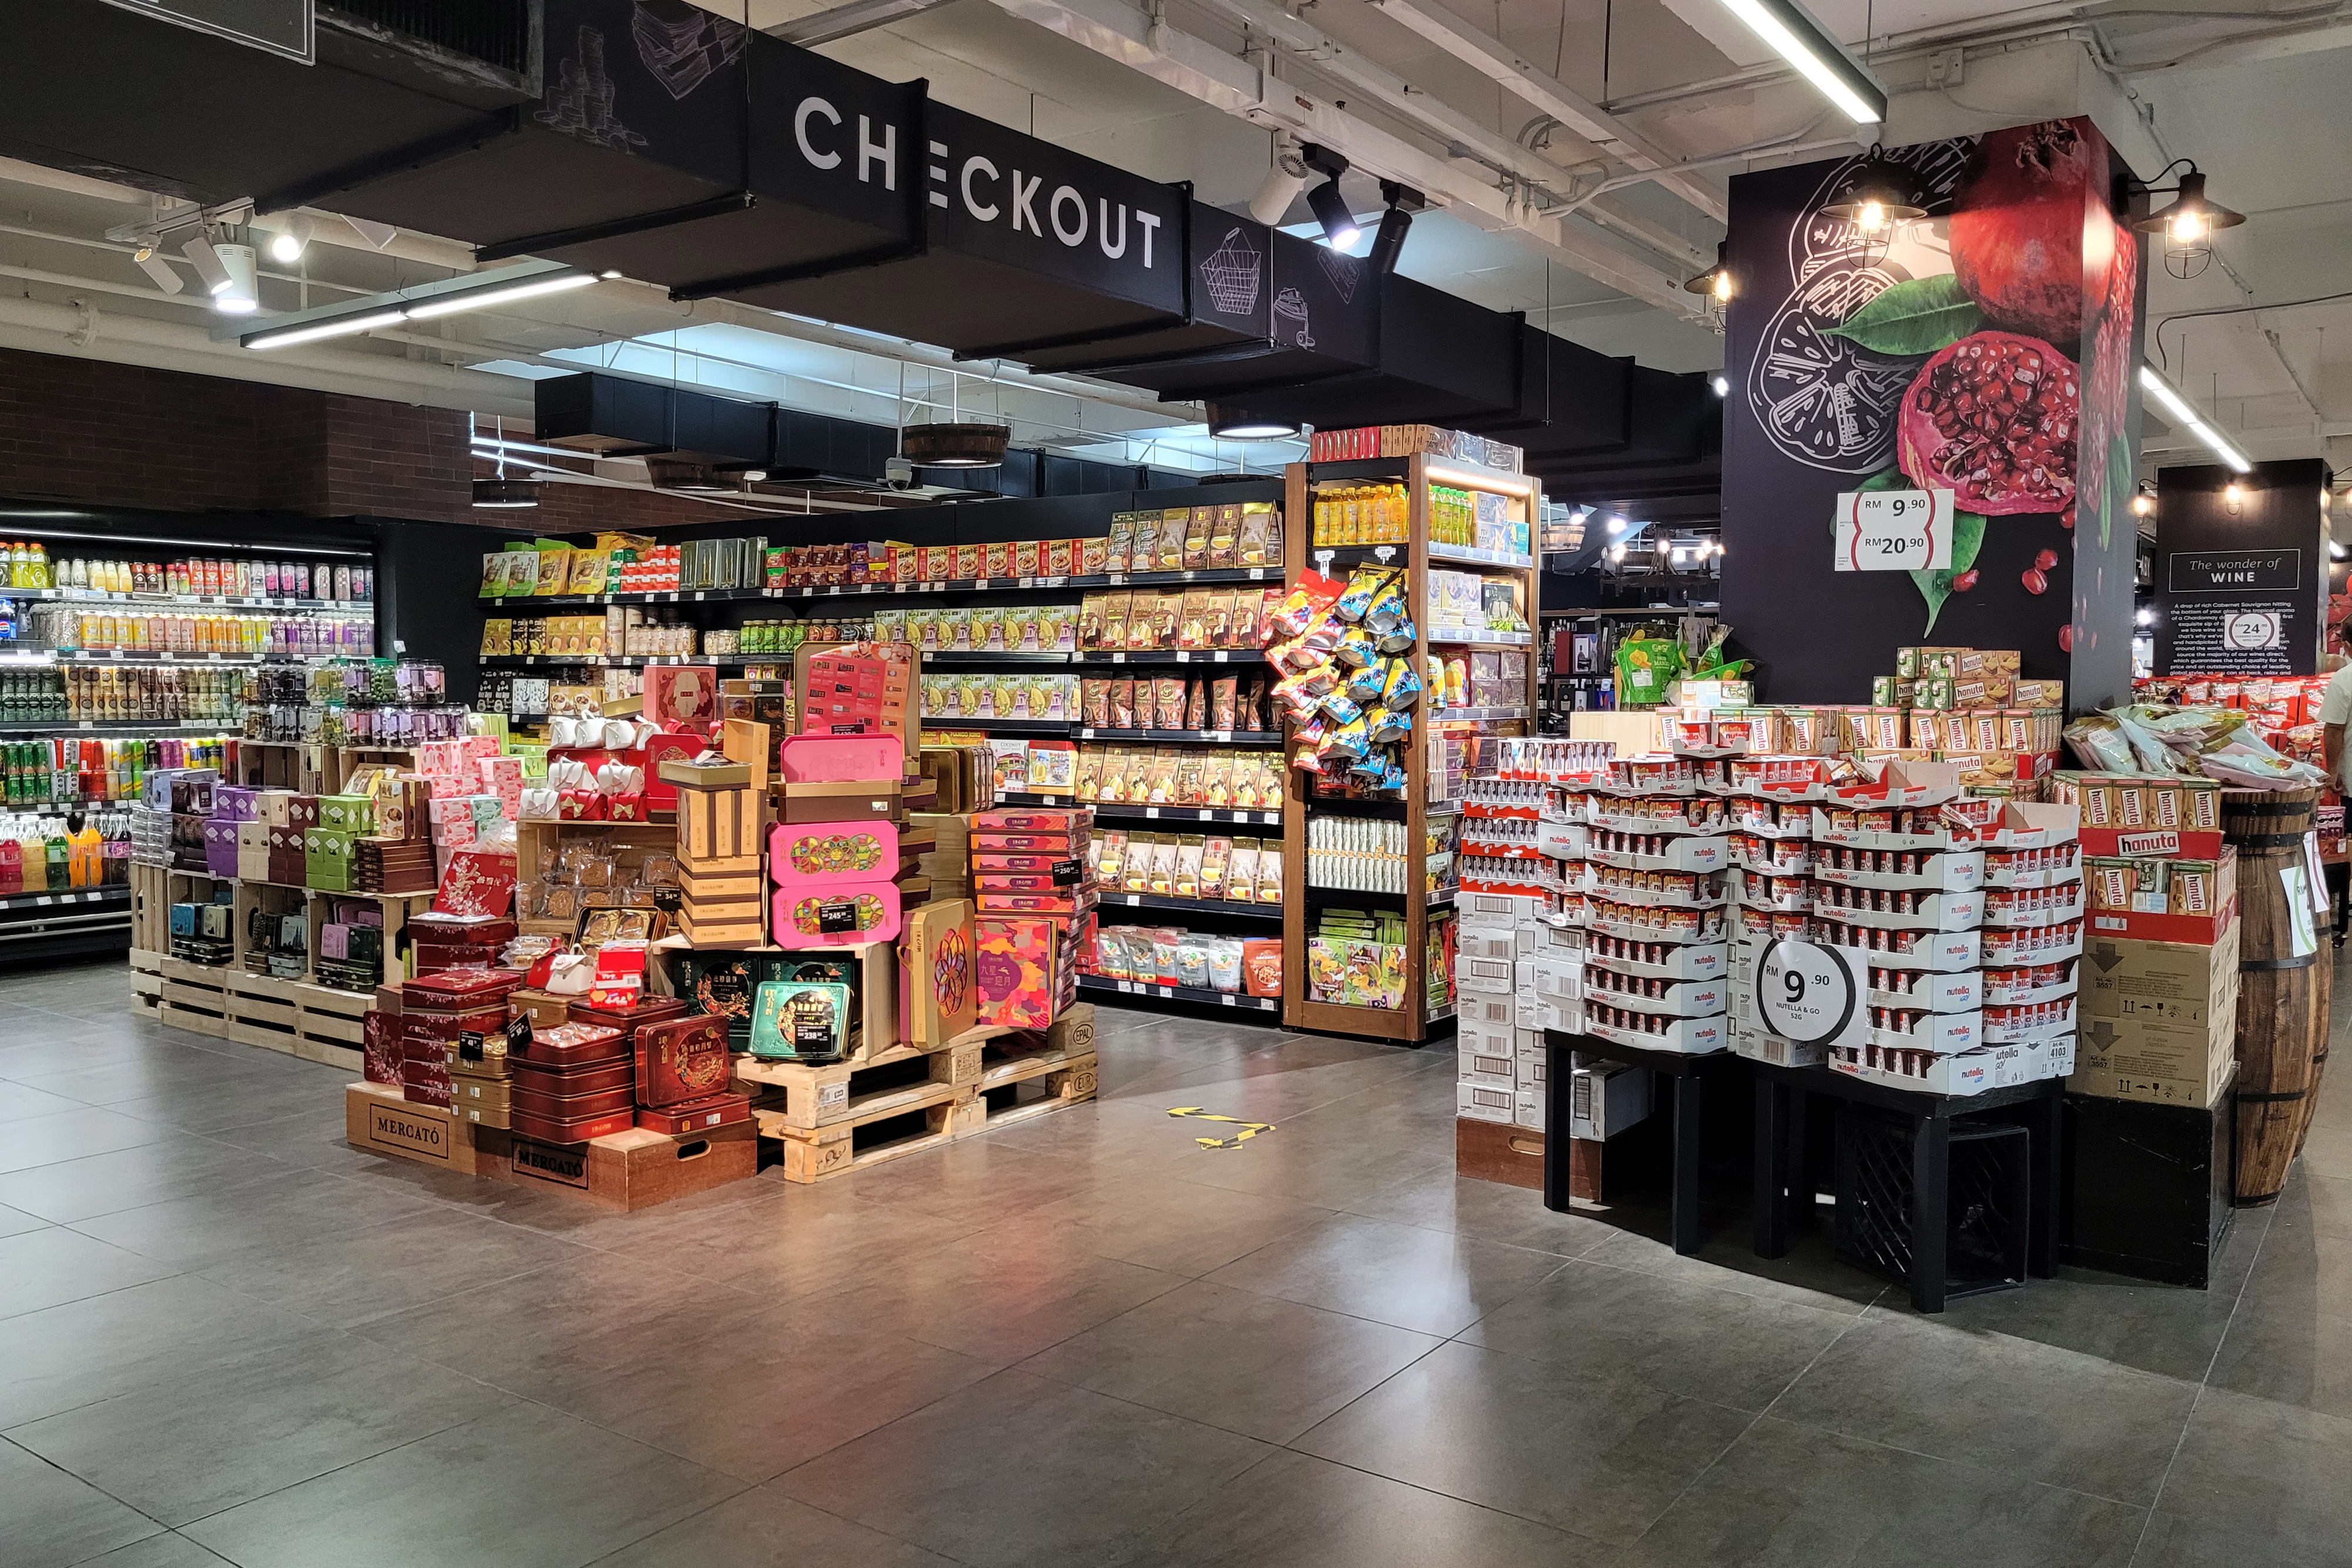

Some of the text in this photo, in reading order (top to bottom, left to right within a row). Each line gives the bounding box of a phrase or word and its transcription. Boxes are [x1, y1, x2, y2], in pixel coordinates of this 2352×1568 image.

[795, 96, 1161, 269] CHECKOUT
[1865, 500, 1881, 508] RM
[2190, 558, 2281, 570] The wonder of
[2211, 572, 2254, 582] WINE
[1963, 658, 1982, 669] hanuta
[1958, 685, 1984, 697] hanuta
[2018, 687, 2041, 699] hanuta
[1755, 719, 1766, 749] hanuta
[1797, 720, 1808, 750] hanuta
[1854, 718, 1865, 748] hanuta
[1882, 718, 1894, 747] hanuta
[1920, 720, 1933, 748] hanuta
[1951, 721, 1963, 748] hanuta
[1982, 721, 1993, 749] hanuta
[2012, 721, 2025, 751] hanuta
[2091, 790, 2105, 823] hanuta
[2125, 791, 2139, 824] hanuta
[2160, 792, 2174, 825] hanuta
[2198, 793, 2212, 826] hanuta
[1550, 836, 1570, 845] nutella
[2121, 833, 2177, 852] hanuta
[1954, 866, 1973, 875] nutella
[2109, 871, 2122, 904] hanuta
[2187, 876, 2201, 909] hanuta
[1951, 906, 1971, 914] nutella
[1745, 920, 1771, 928] nutella
[1946, 944, 1968, 954] nutella
[1694, 956, 1716, 965] nutella
[1766, 964, 1778, 977] RM
[1591, 993, 1609, 1001] nutella
[1694, 992, 1716, 1002] nutella
[1946, 986, 1969, 996] nutella
[1776, 1002, 1801, 1012] NUTELLA
[1076, 1028, 1090, 1041] EPAL
[1592, 1027, 1609, 1036] nutella
[1696, 1028, 1716, 1038] nutella
[1947, 1026, 1969, 1036] nutella
[2051, 1047, 2066, 1057] 4103
[1837, 1063, 1858, 1073] nutella
[1962, 1068, 1984, 1078] nutella
[378, 1117, 440, 1144] MERCATÓ
[518, 1150, 584, 1178] MERCATÓ
